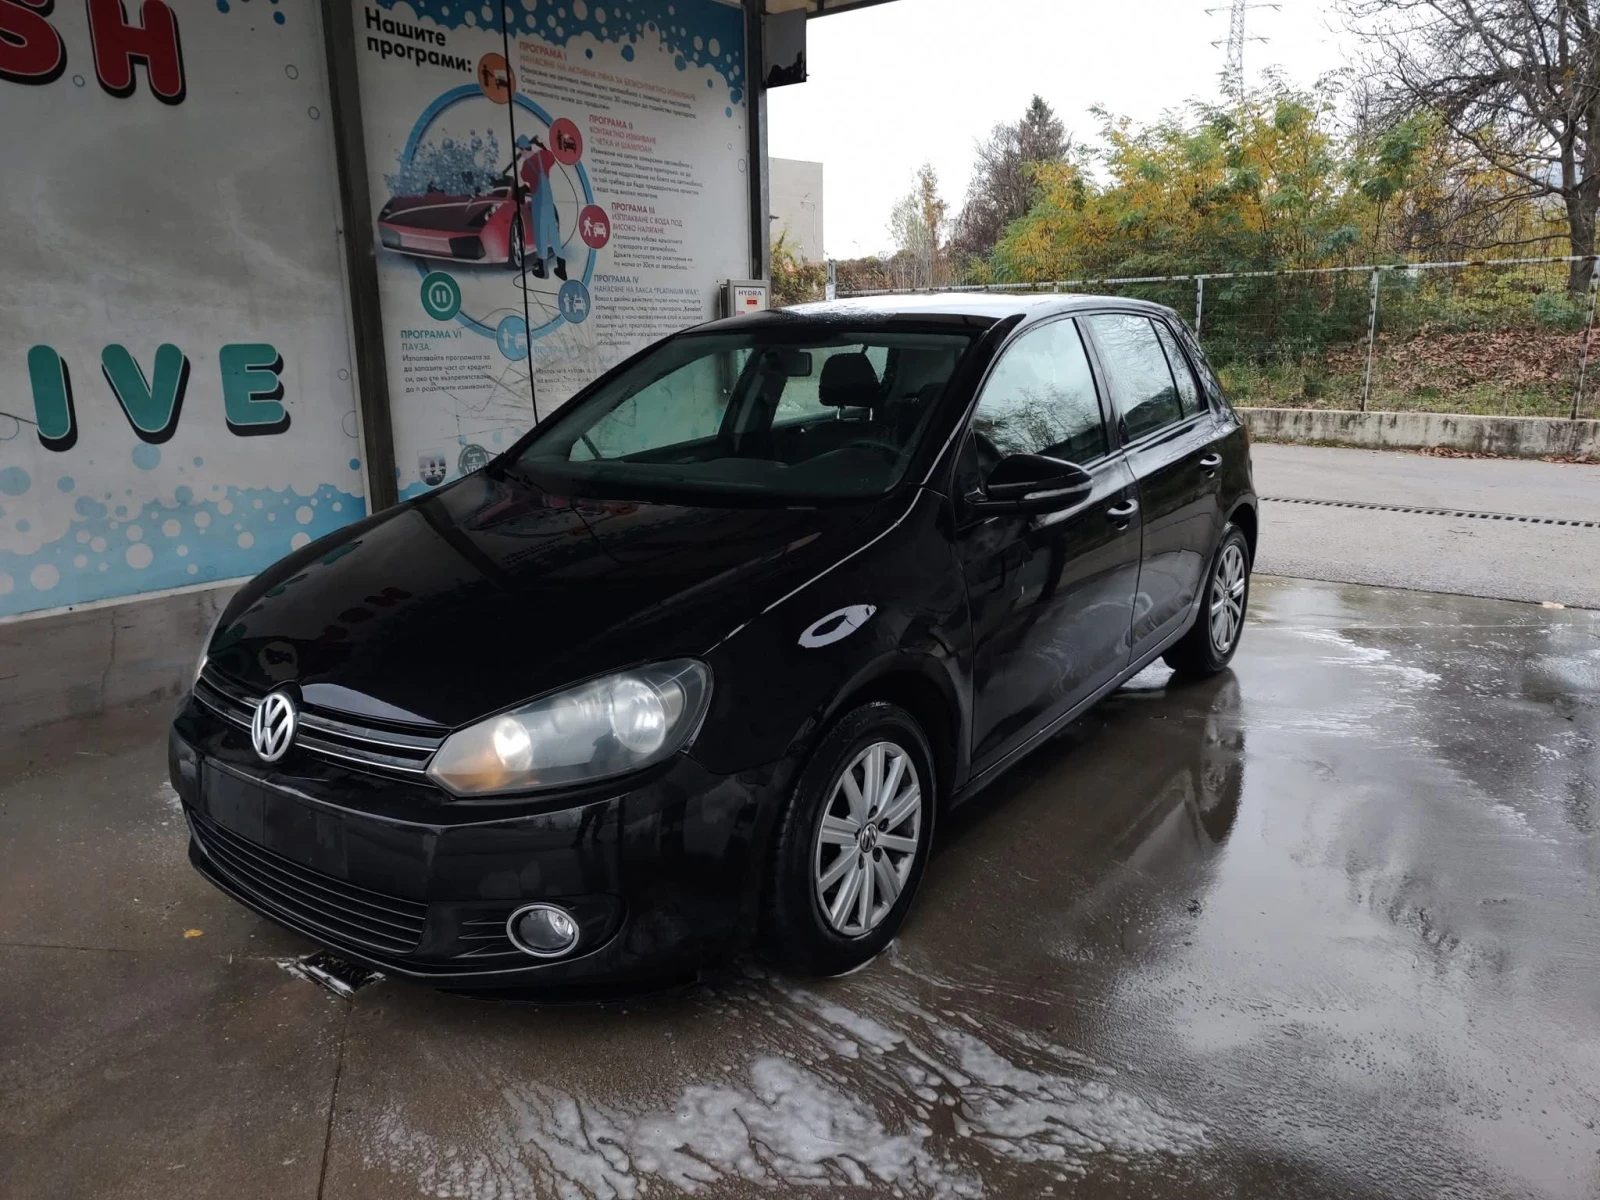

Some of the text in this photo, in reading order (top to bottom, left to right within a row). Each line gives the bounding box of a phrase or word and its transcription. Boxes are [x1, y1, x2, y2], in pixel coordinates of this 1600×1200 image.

[365, 6, 446, 46] Нашите
[367, 36, 472, 73] програми:
[520, 42, 562, 59] ПРОГРАМА
[588, 114, 626, 128] ПРОГРАМА
[589, 126, 656, 144] КОНТАКТНО ИЗМИВАНЕ
[595, 137, 613, 146] ЧЕТКА
[611, 202, 647, 213] ПРОГРАМА
[612, 212, 648, 223] ИЗПЛАКВАНЕ
[612, 222, 636, 231] ВИСОКО
[594, 274, 630, 282] ПРОГРАМА
[252, 692, 296, 762] VW
